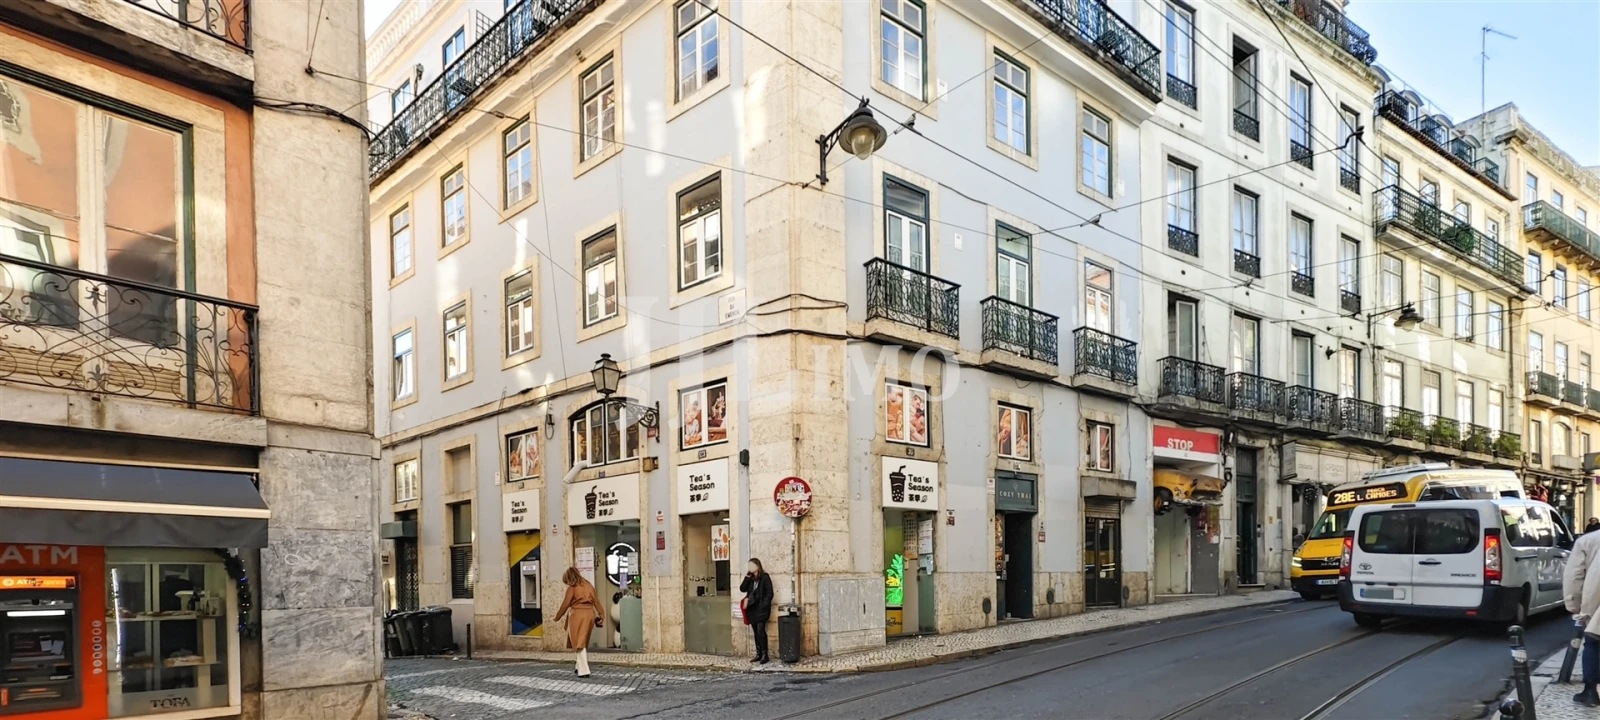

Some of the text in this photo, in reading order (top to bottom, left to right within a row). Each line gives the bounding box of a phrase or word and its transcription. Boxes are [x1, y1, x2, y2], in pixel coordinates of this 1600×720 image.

[1167, 438, 1194, 451] STOP
[689, 474, 711, 483] Tea's
[908, 474, 930, 483] Tea's
[689, 483, 715, 492] Season
[908, 483, 934, 492] Season
[598, 491, 615, 499] Tea's
[1334, 491, 1356, 504] 28E
[598, 499, 619, 507] Season
[0, 544, 78, 565] ATM
[150, 697, 191, 709] TOFA
